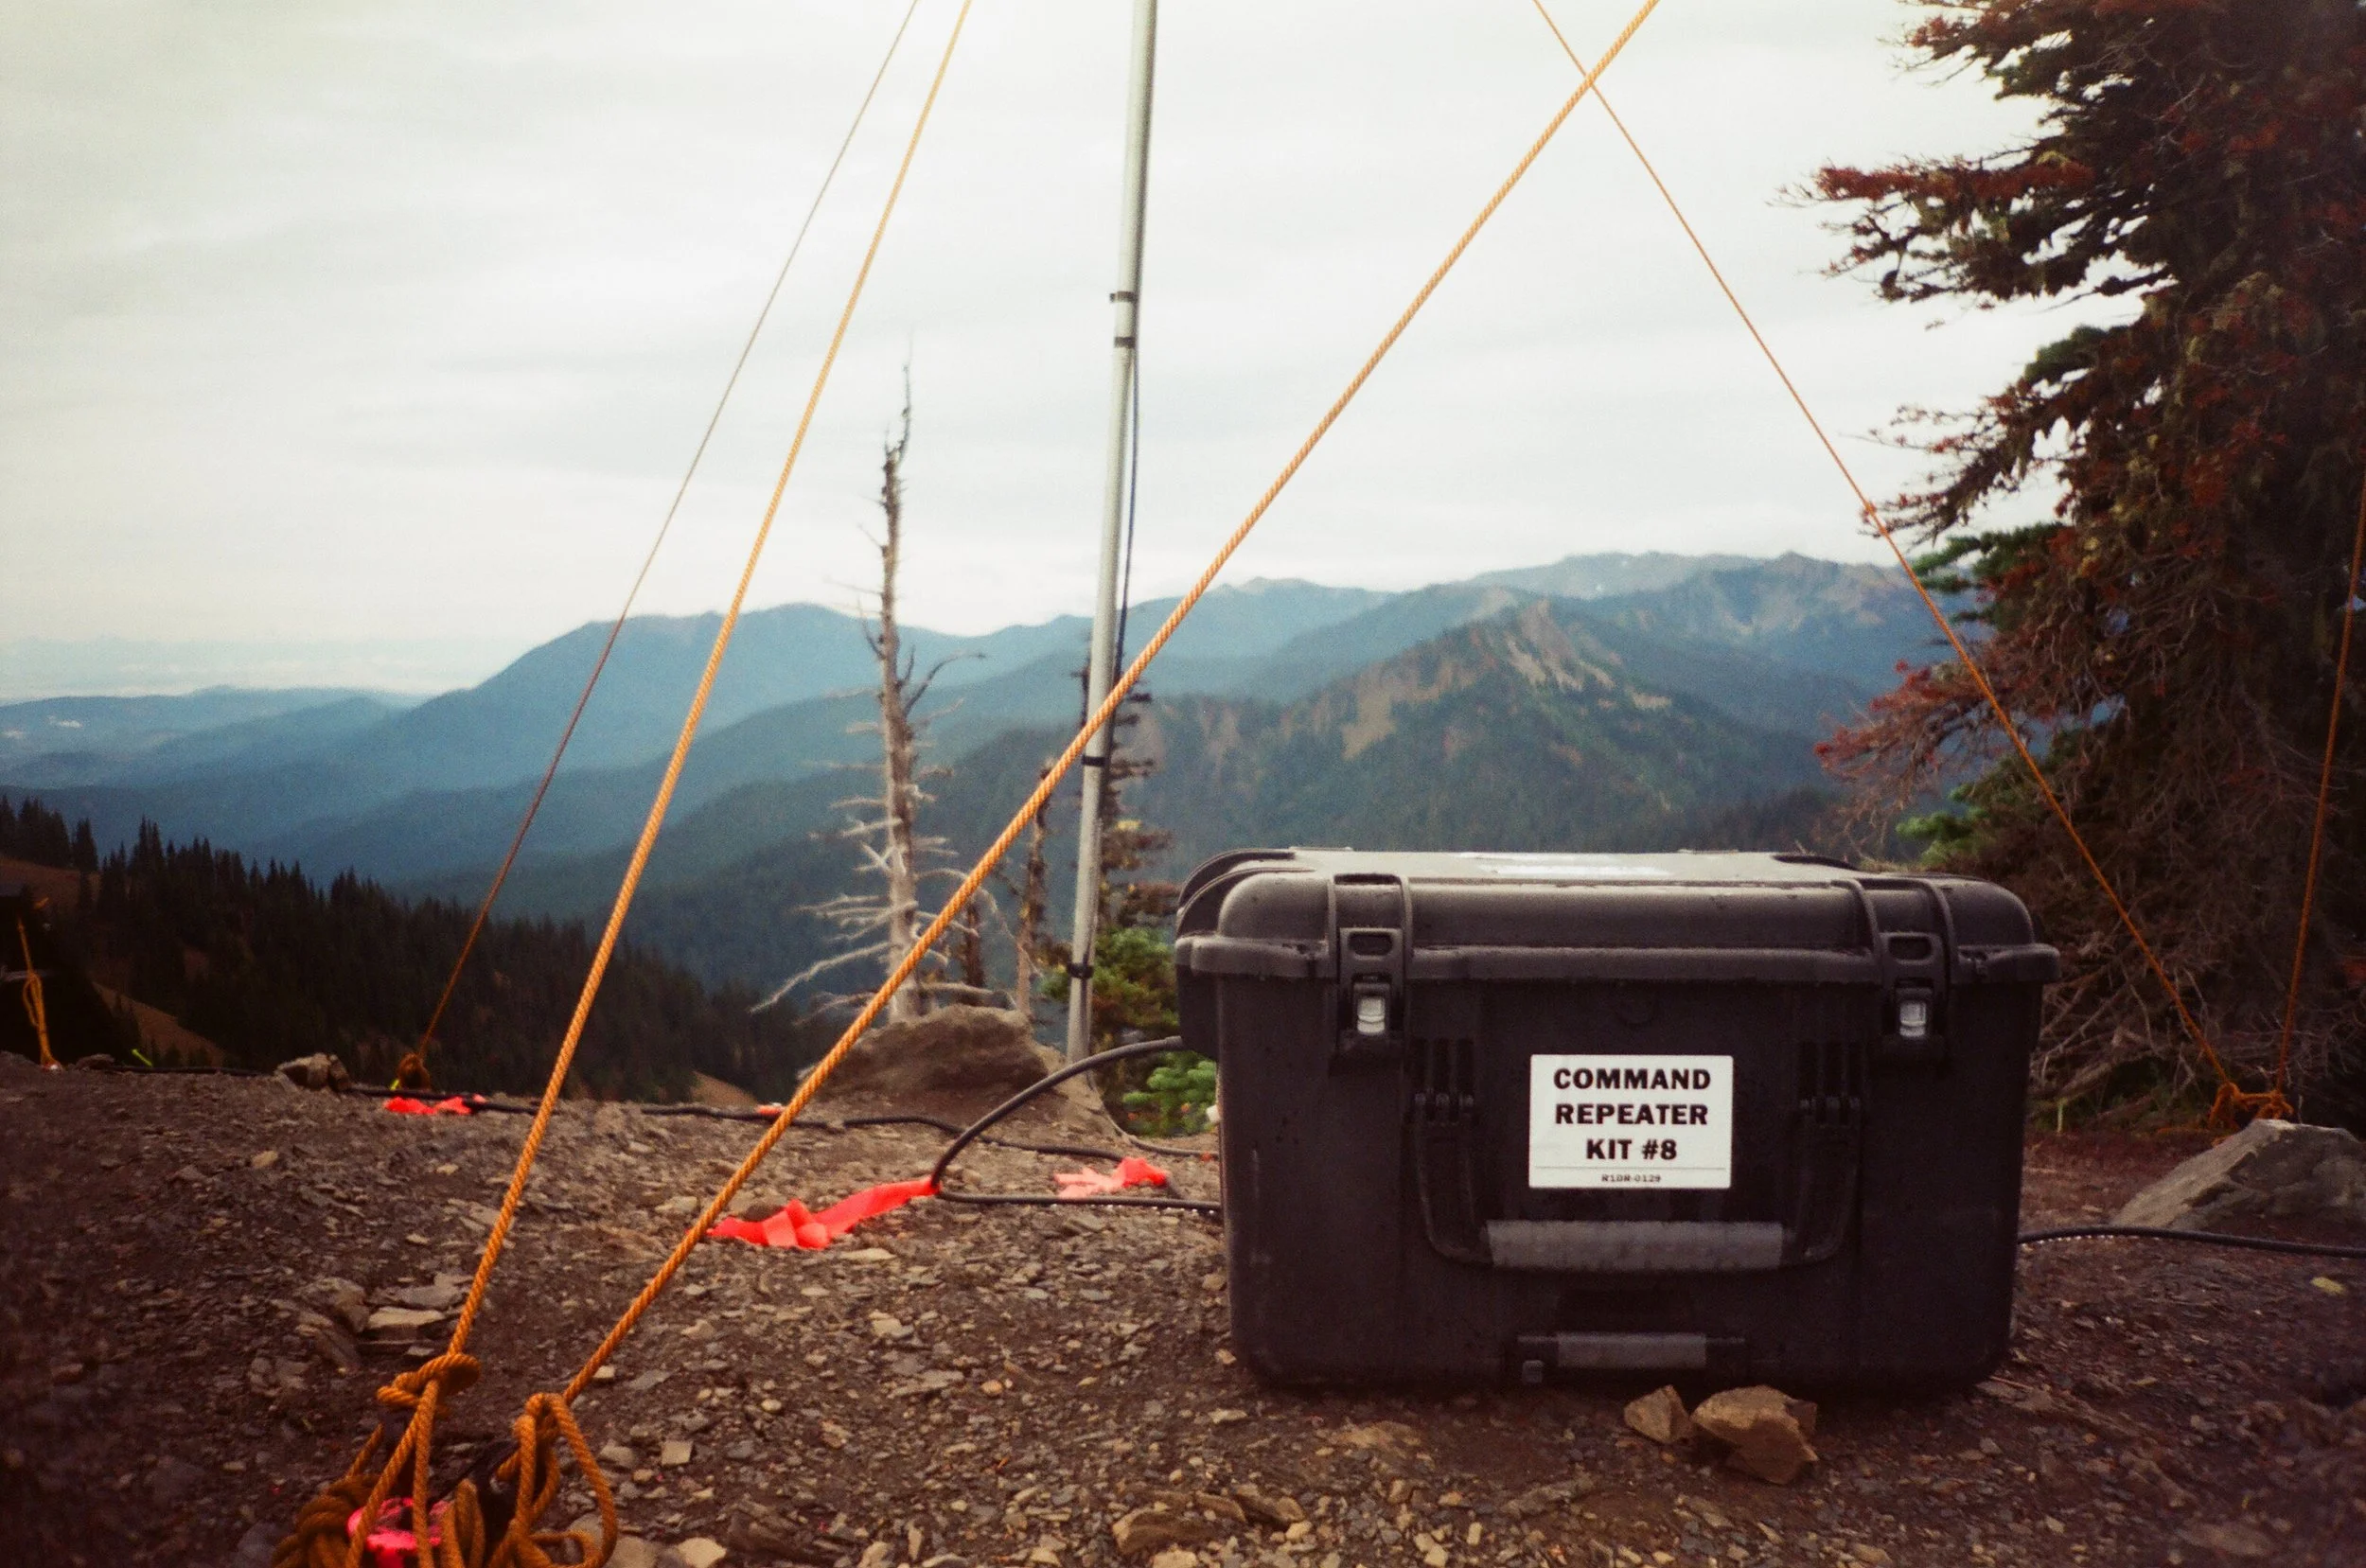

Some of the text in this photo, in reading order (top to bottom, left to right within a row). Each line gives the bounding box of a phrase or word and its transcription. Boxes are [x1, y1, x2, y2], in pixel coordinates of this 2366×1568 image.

[1553, 1067, 1711, 1090] COMMAND
[1555, 1102, 1708, 1125] REPEATER
[1586, 1138, 1677, 1160] KIT #8
